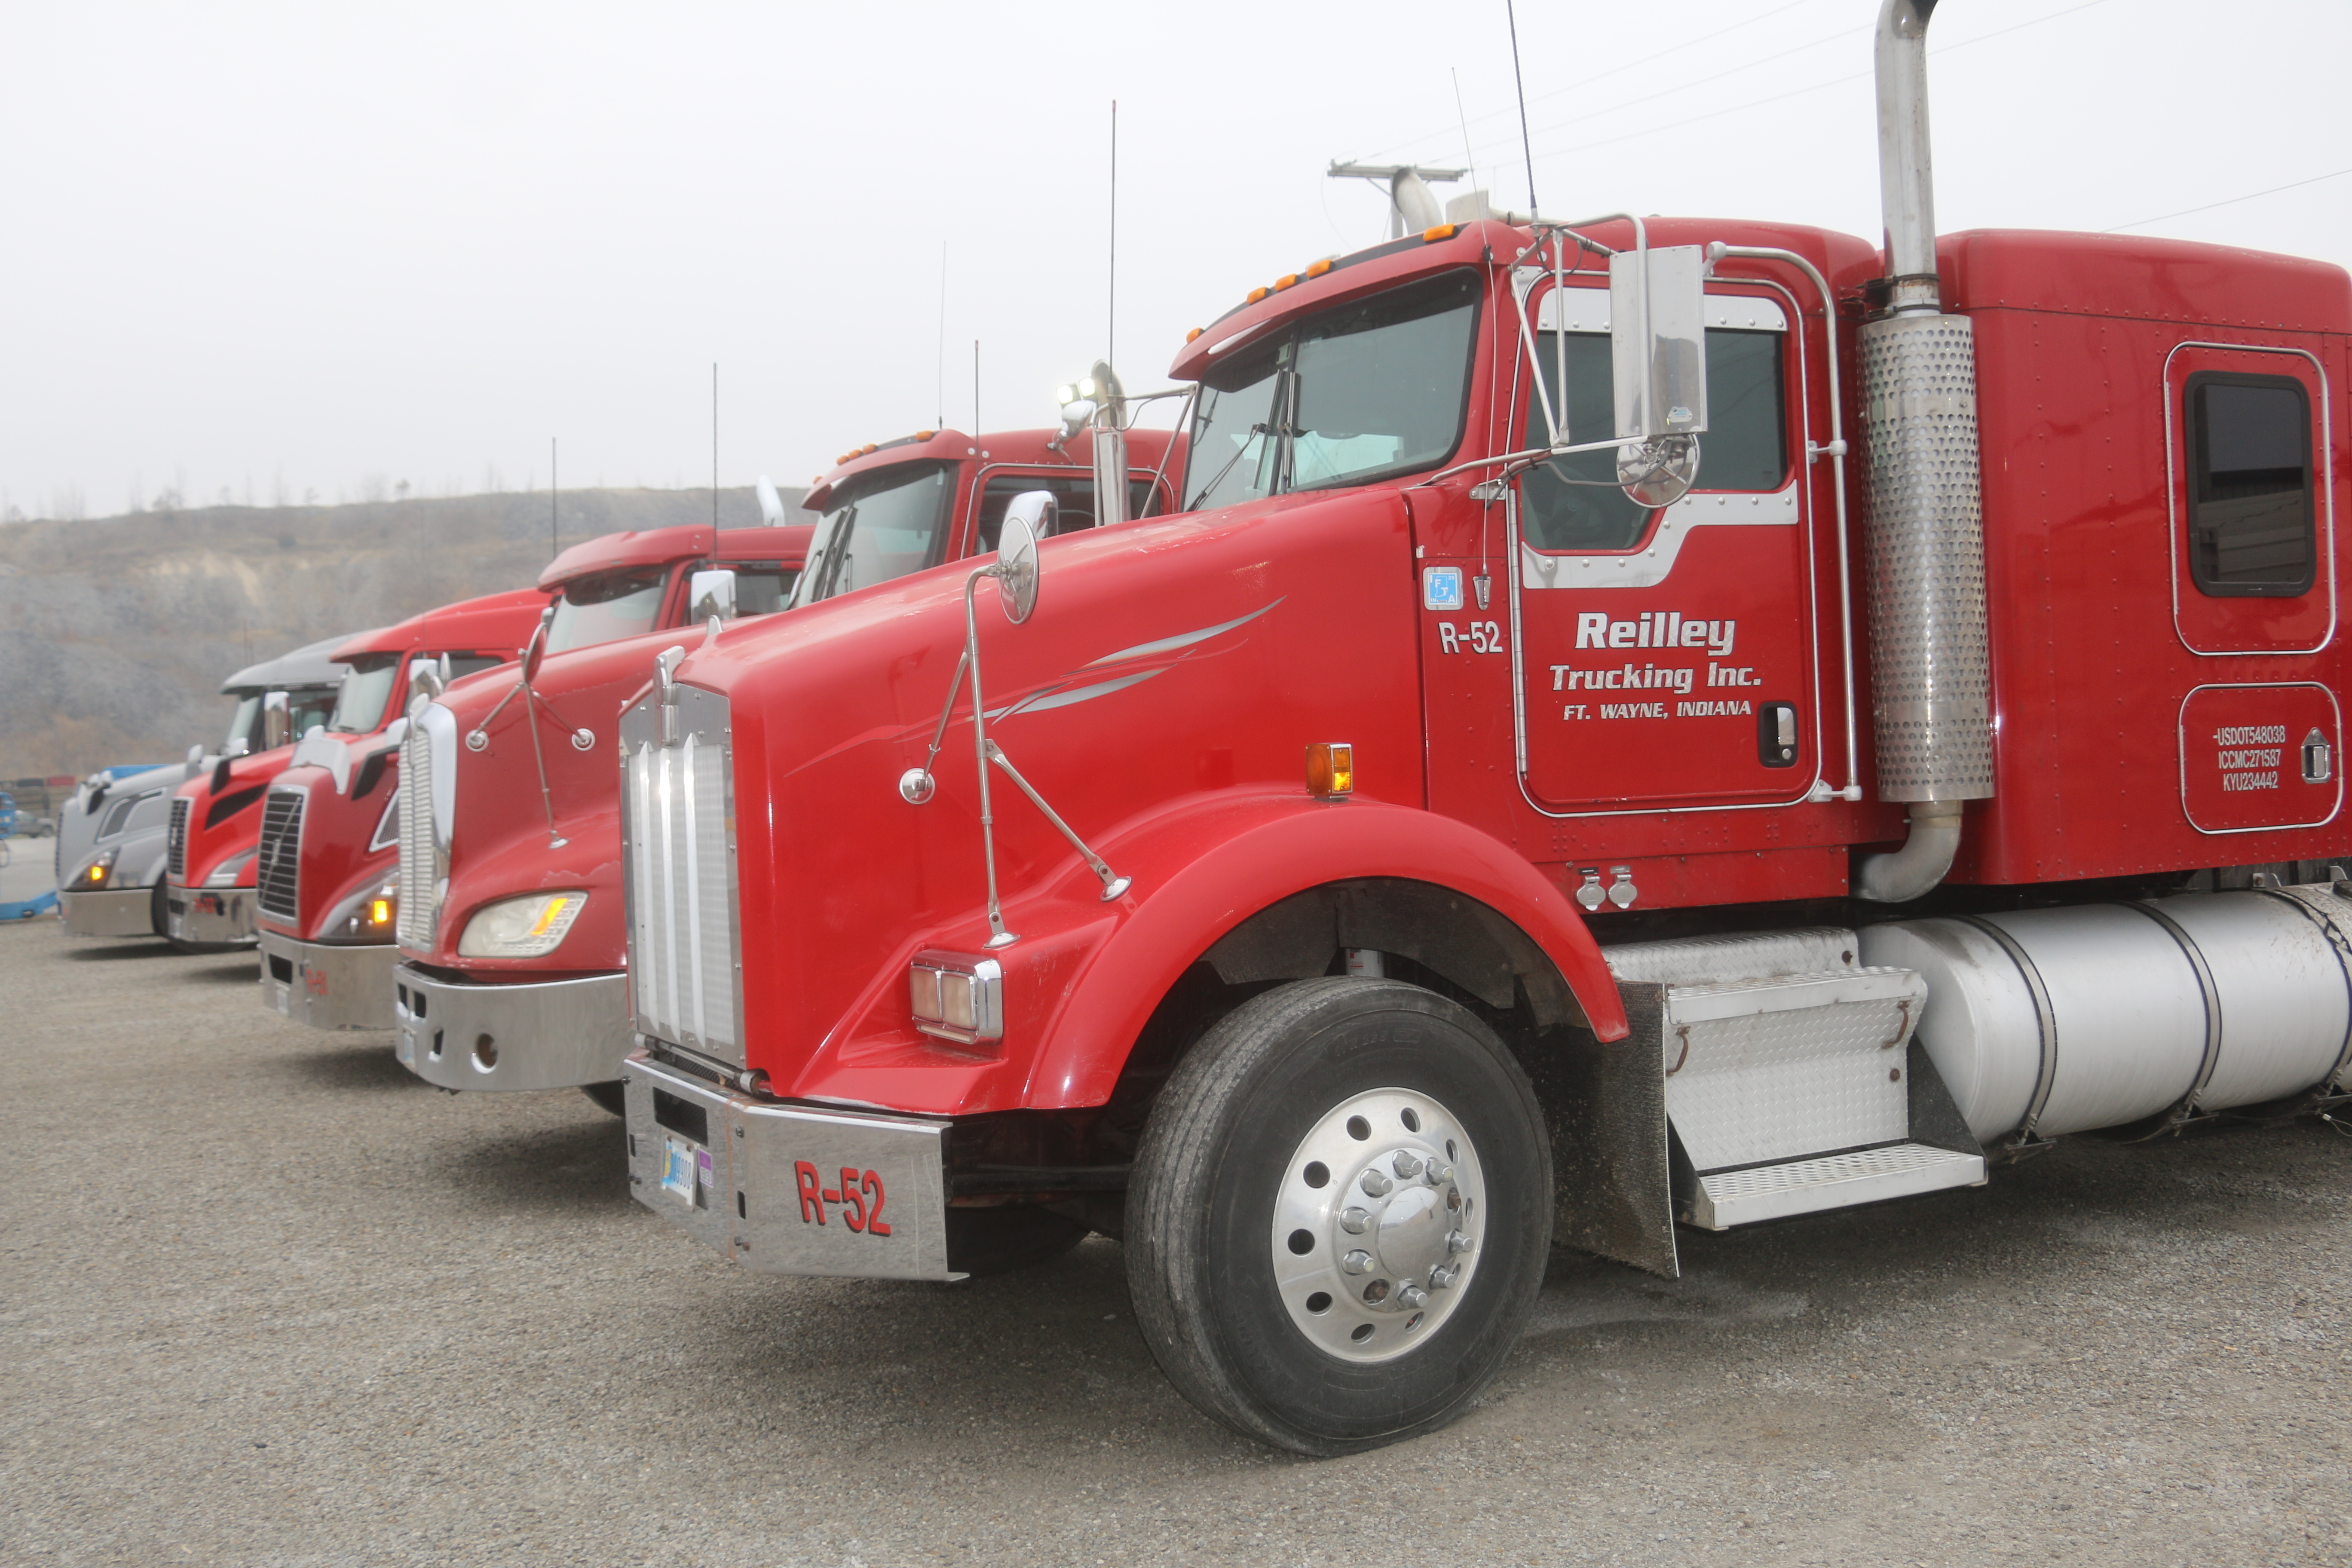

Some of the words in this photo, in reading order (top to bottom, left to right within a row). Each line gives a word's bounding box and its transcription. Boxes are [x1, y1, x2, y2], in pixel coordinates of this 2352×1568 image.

[1438, 621, 1503, 654] R-52
[1574, 612, 1736, 656] Reilley
[1549, 663, 1694, 694] Trucking
[1707, 662, 1761, 686] Inc.
[1563, 704, 1591, 720] FT.
[1600, 702, 1669, 720] WAYNE,
[1676, 700, 1752, 717] INDIANA
[2218, 748, 2281, 769] ICCMC271587
[2223, 771, 2278, 791] KYU234442
[794, 1160, 891, 1237] R-52
